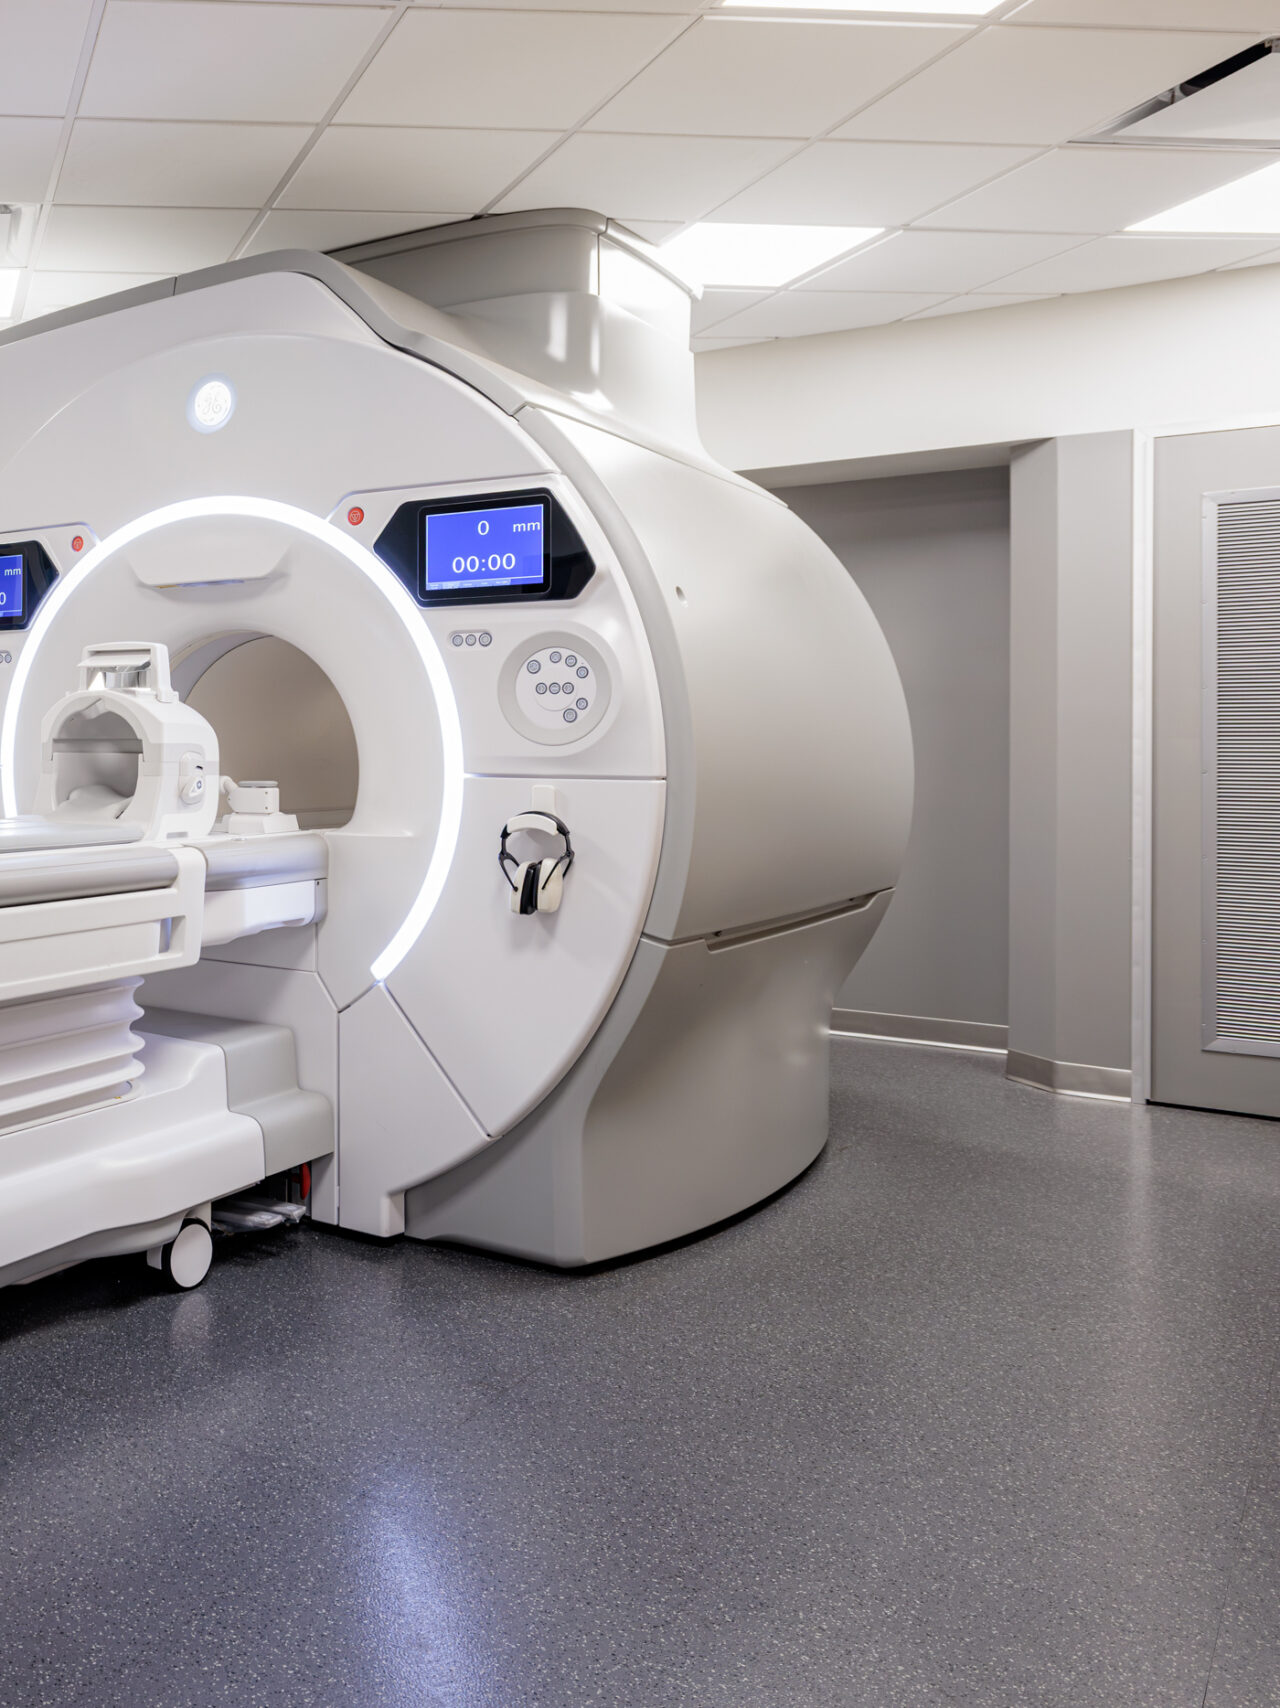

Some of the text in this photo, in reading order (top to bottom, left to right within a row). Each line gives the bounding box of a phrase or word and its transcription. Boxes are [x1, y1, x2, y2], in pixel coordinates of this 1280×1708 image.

[477, 520, 540, 536] 0 mm
[452, 553, 516, 573] 00:00
[4, 567, 21, 577] mm
